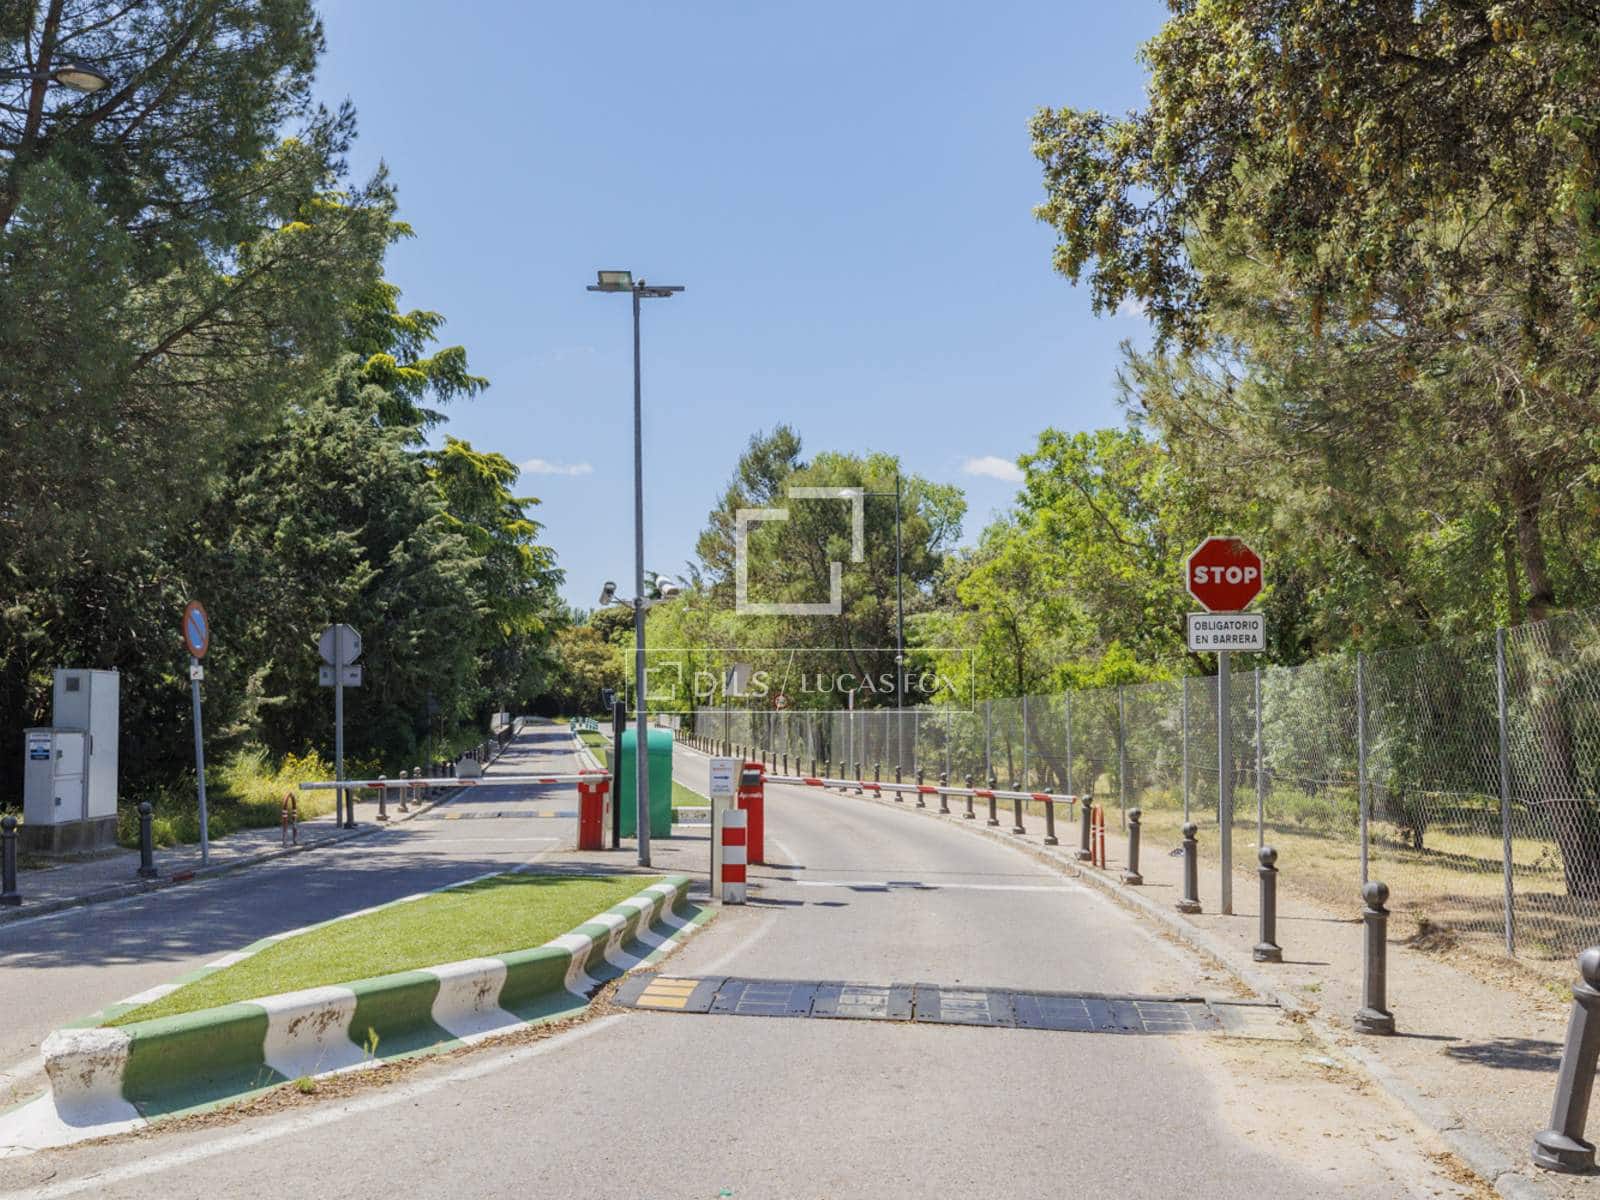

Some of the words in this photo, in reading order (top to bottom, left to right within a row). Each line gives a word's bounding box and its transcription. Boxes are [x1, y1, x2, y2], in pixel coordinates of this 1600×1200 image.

[1193, 566, 1258, 585] STOP
[1194, 621, 1259, 631] OBLIGATORIO
[1195, 635, 1209, 644] EN
[1213, 634, 1258, 644] BARRERA
